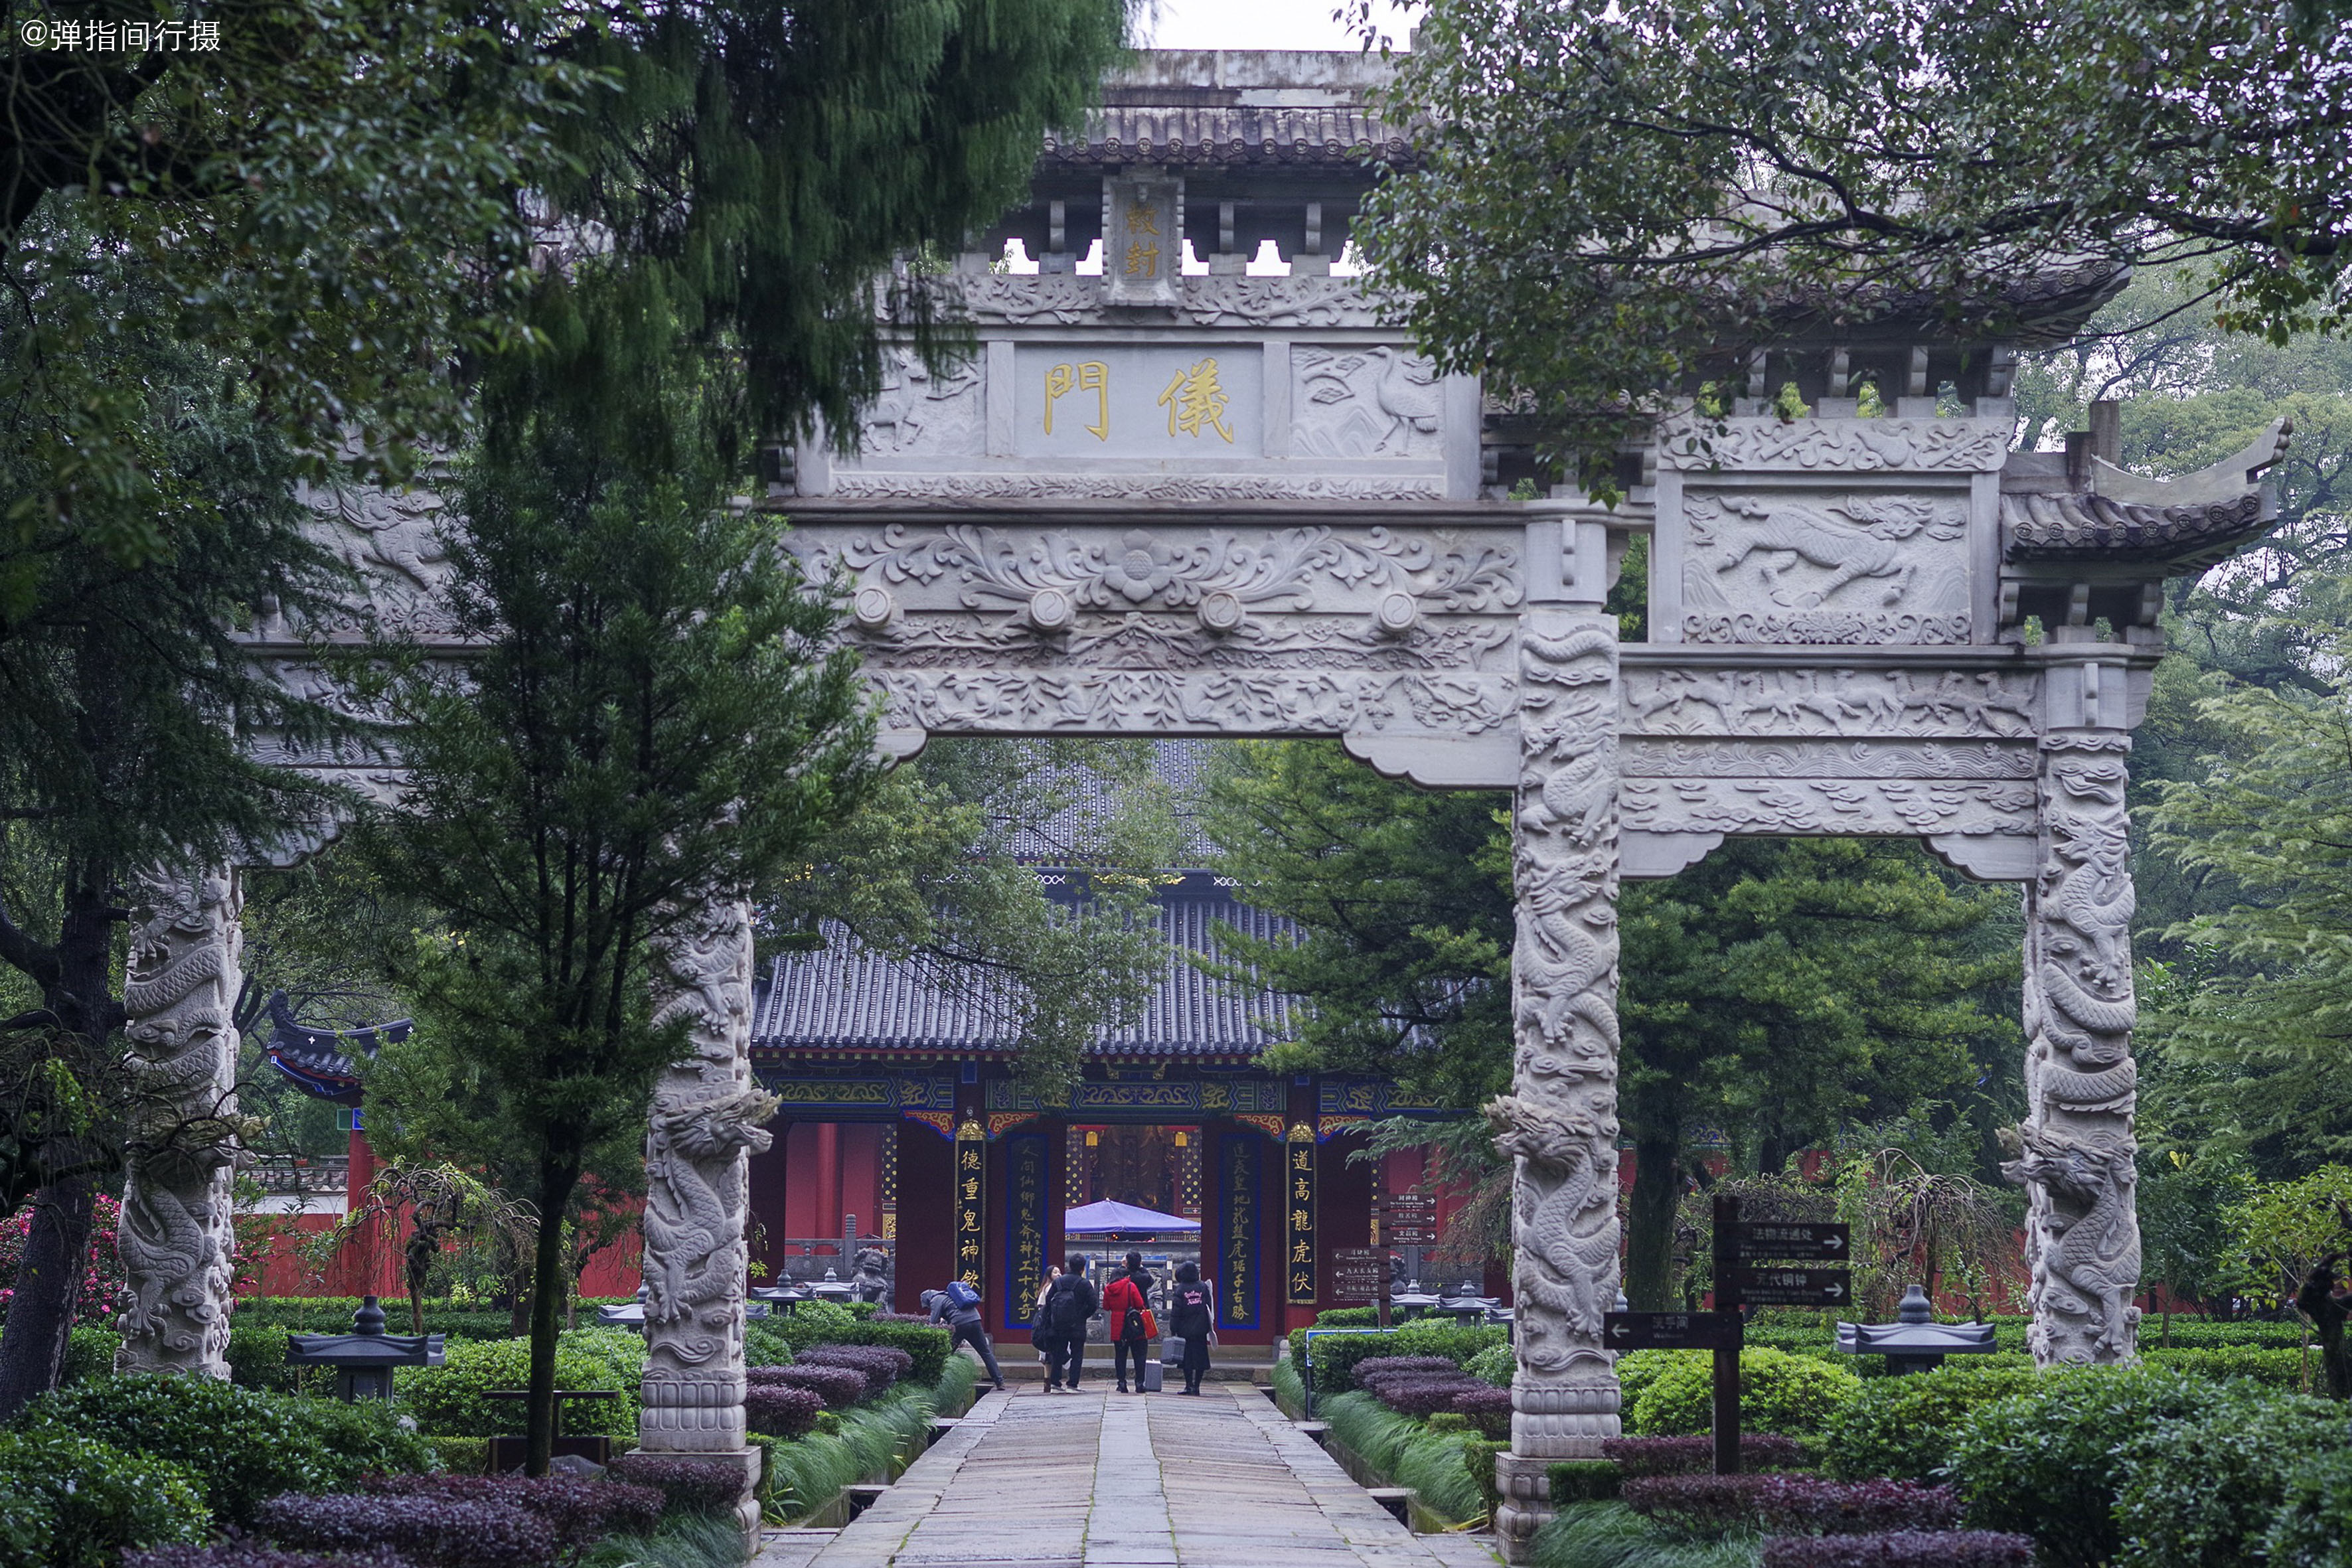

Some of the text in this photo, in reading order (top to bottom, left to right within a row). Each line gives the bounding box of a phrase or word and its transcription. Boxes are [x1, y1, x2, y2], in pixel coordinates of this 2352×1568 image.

[1291, 1150, 1312, 1292] 道高龍虎伏
[1757, 1273, 1807, 1287] 元代铜钟
